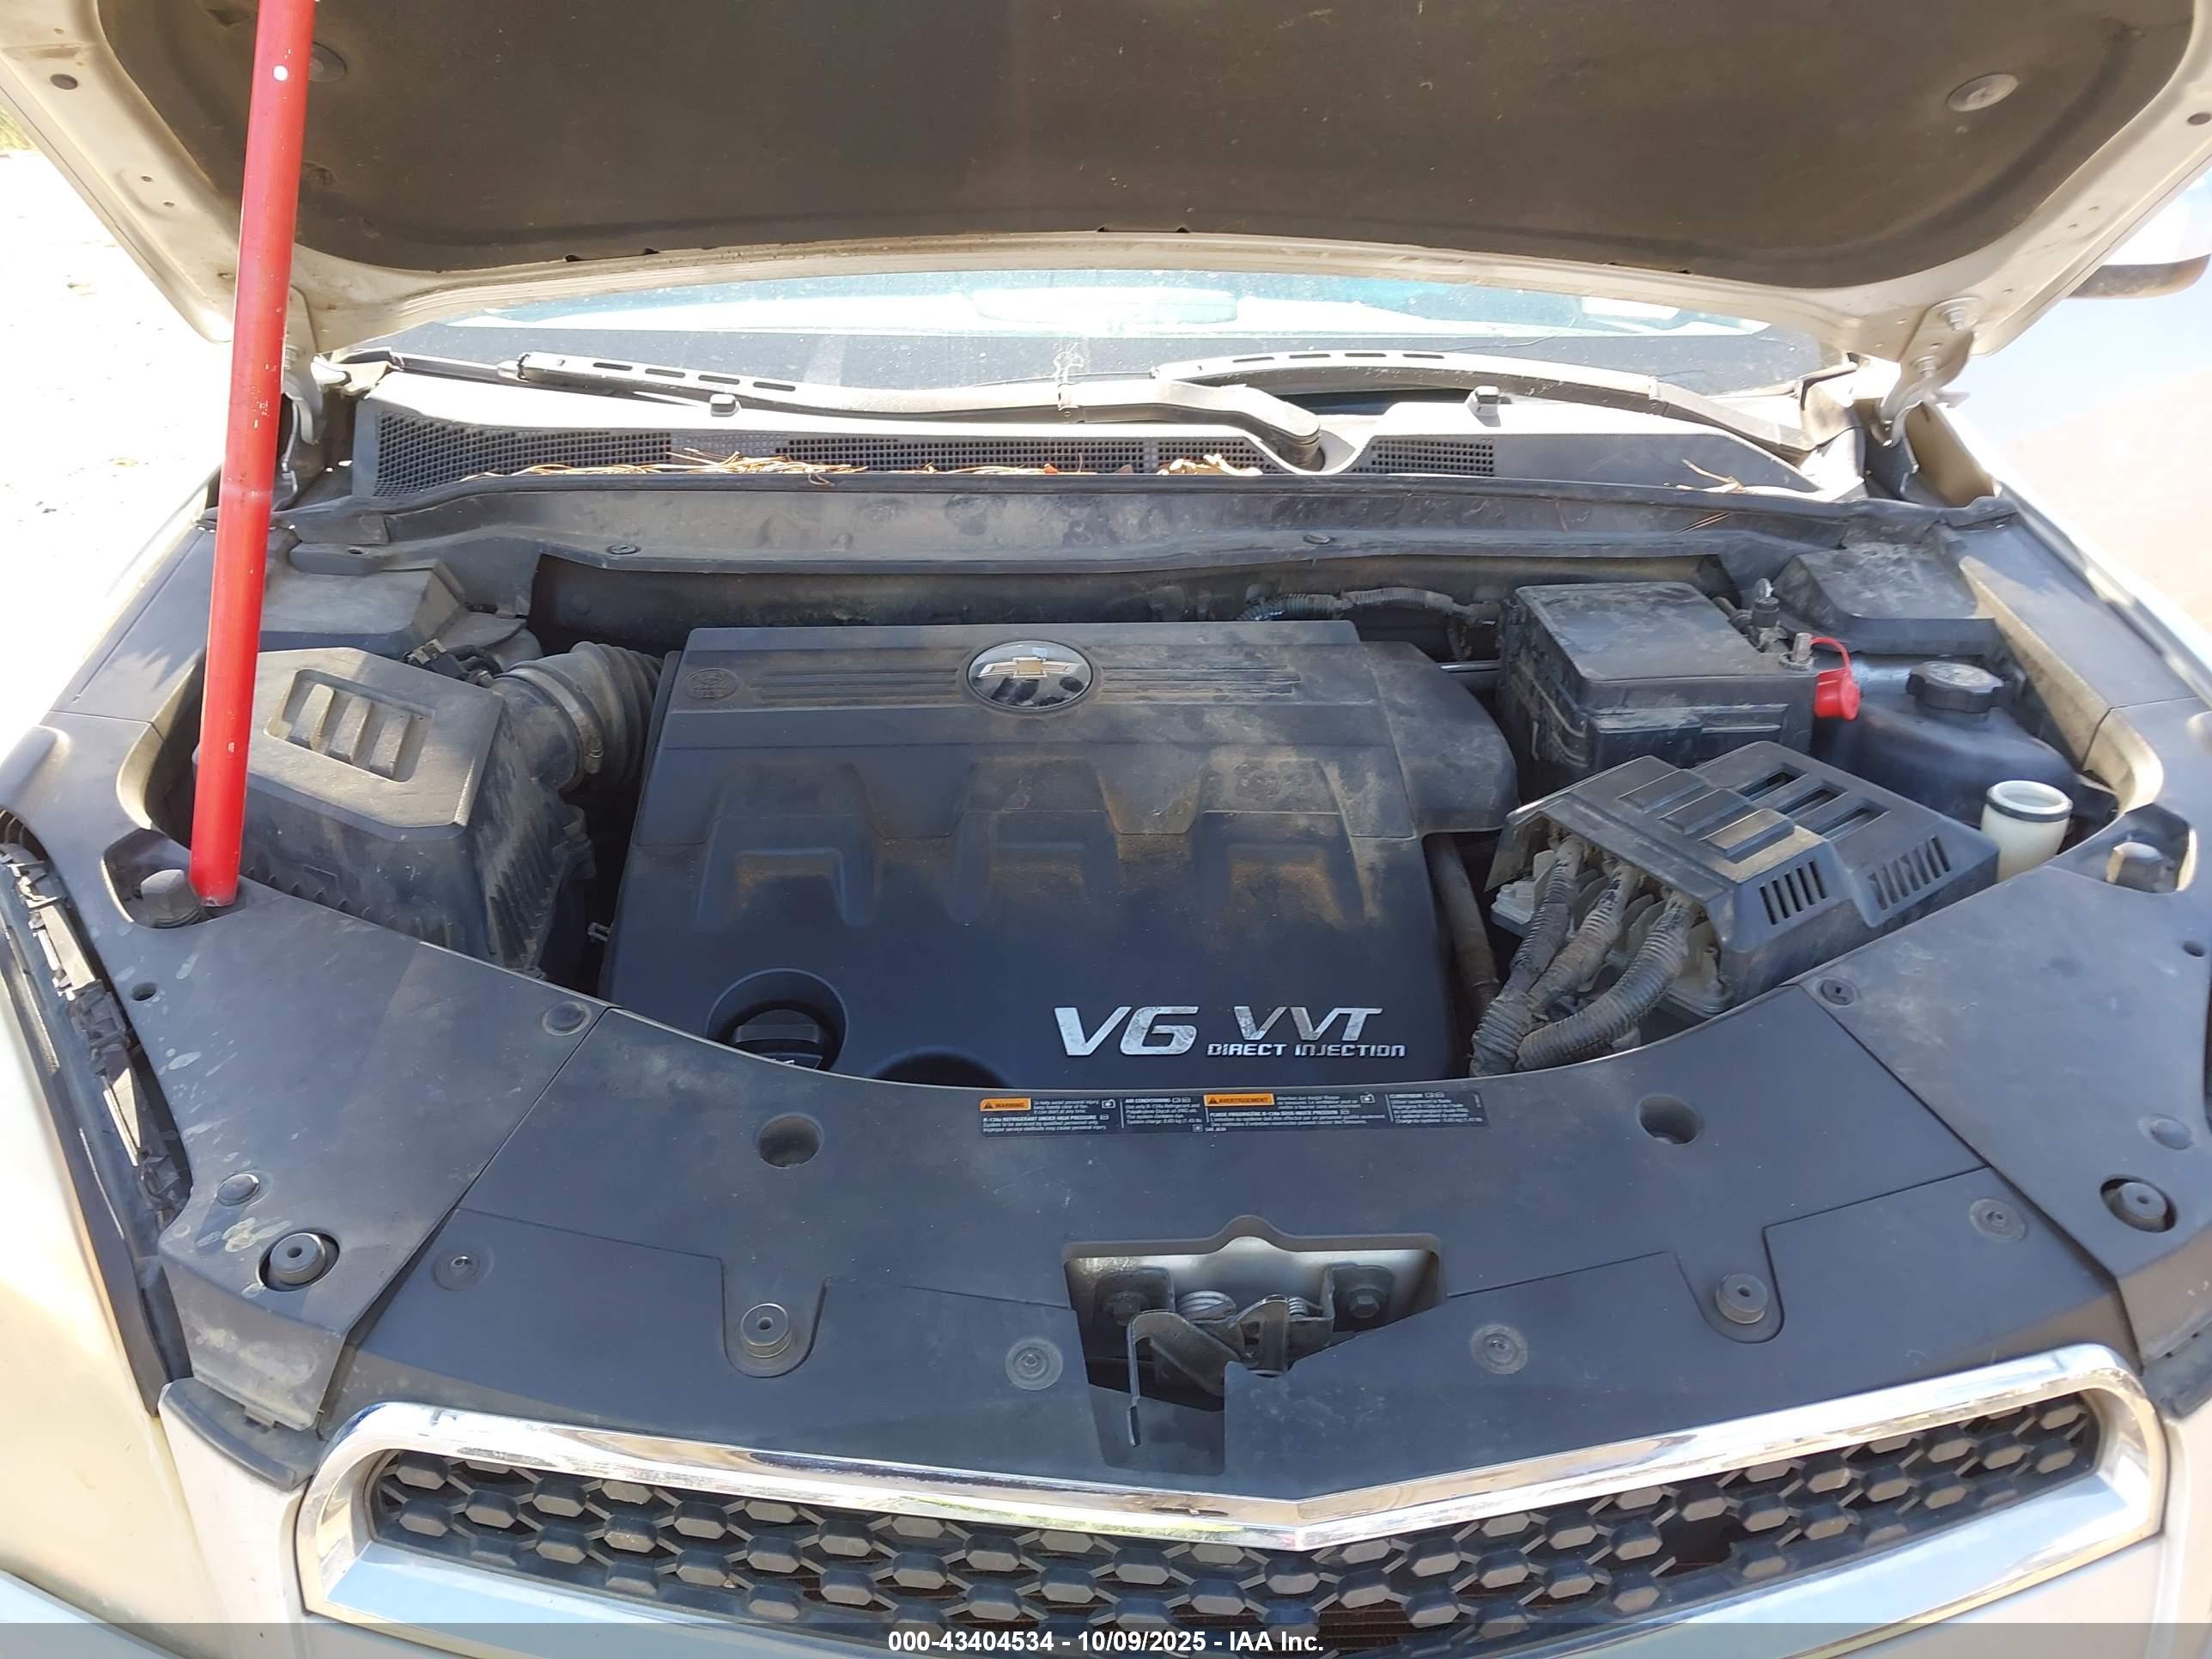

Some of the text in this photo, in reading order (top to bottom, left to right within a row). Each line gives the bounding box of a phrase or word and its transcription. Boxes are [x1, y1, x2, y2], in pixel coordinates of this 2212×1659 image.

[1054, 1006, 1383, 1056] V6 VVT
[1206, 1042, 1407, 1057] DIRECT INJECTION
